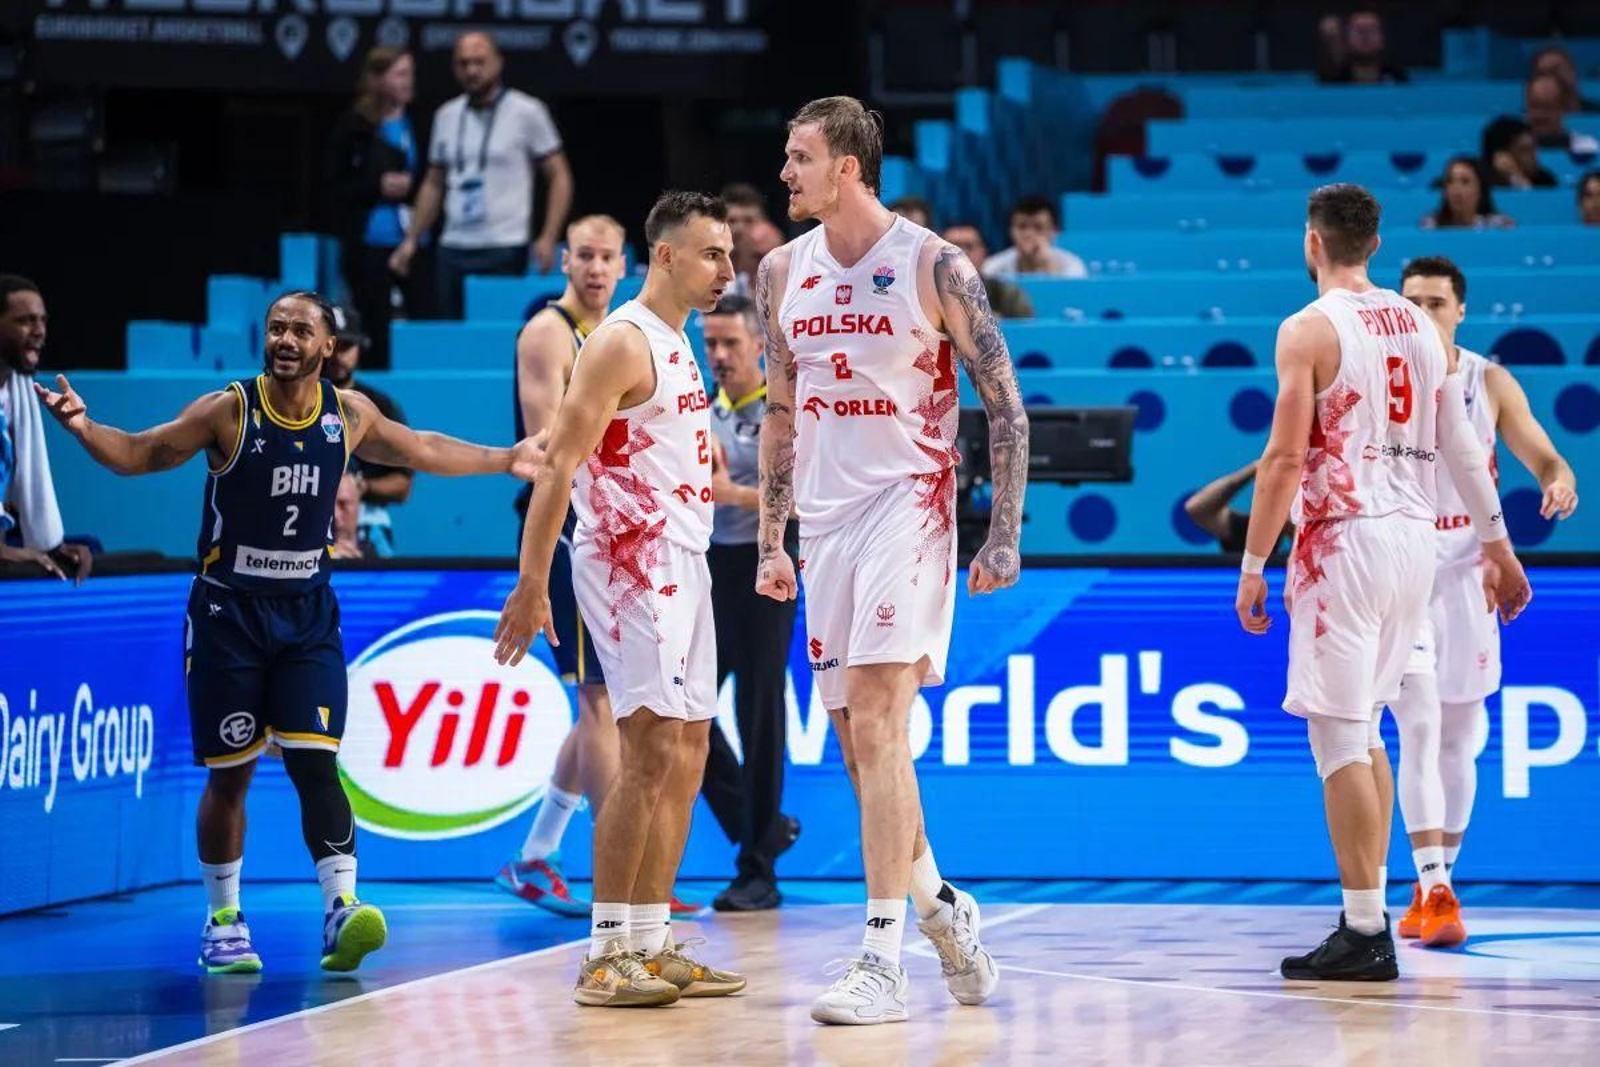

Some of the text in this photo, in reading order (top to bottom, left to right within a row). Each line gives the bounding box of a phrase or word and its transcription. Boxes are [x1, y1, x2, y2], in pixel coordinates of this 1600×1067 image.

[793, 314, 894, 339] POLSKA
[831, 352, 853, 380] 2
[677, 388, 711, 414] POLS
[1386, 356, 1413, 424] 9
[834, 399, 897, 417] ORLEN
[696, 429, 709, 465] 2
[270, 464, 321, 497] BIH
[282, 505, 300, 537] 2
[373, 682, 531, 768] Yili
[716, 651, 1251, 767] Wrld's
[71, 682, 154, 800] Group
[867, 916, 897, 929] 4F
